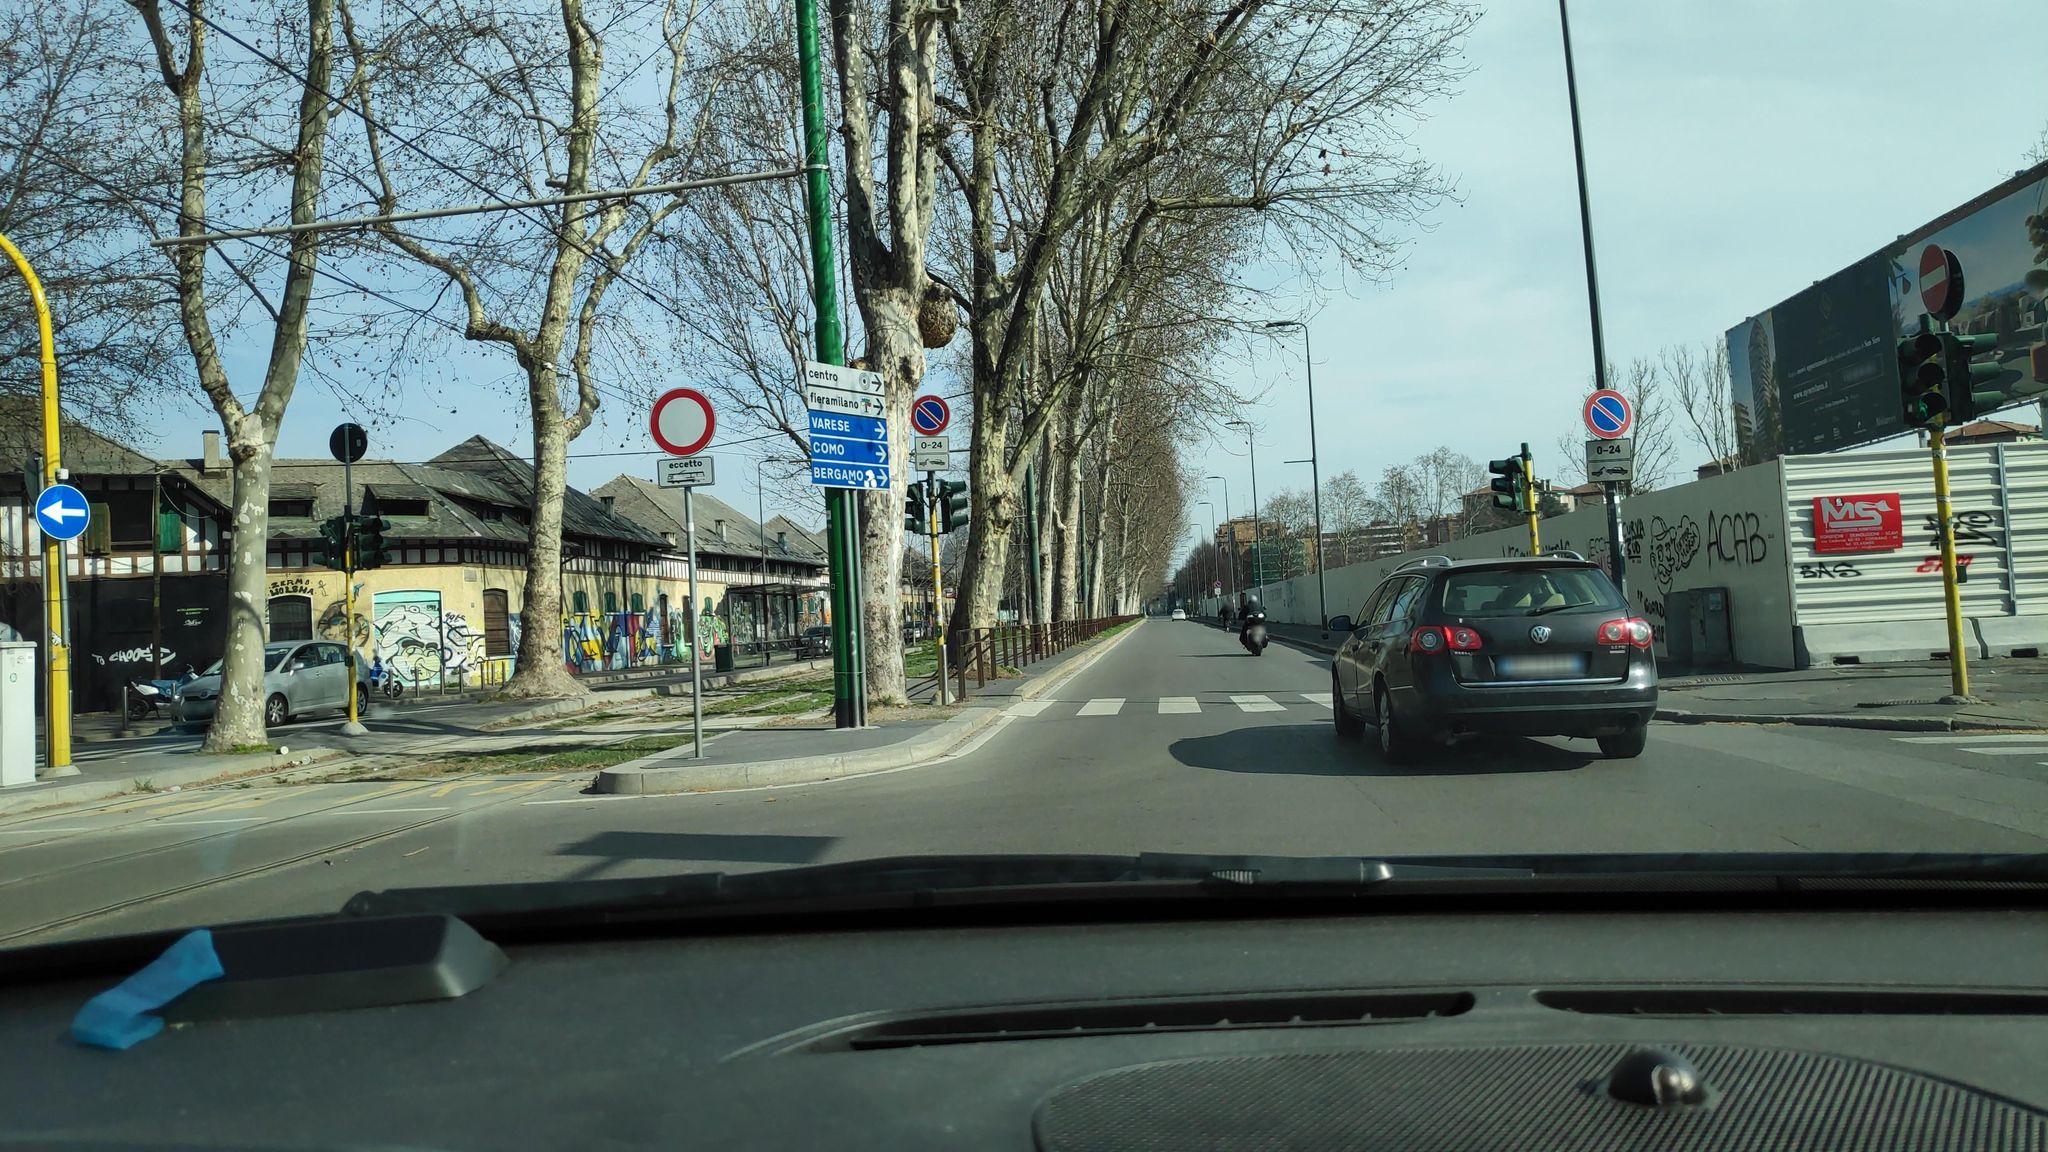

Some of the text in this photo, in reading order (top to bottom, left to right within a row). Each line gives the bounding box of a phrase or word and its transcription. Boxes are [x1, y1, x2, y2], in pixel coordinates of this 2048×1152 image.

[809, 370, 838, 382] centro
[810, 392, 859, 409] fieramilano
[811, 417, 850, 432] VARESE
[813, 442, 845, 455] COMO
[921, 441, 942, 449] 0-24
[1596, 445, 1621, 455] 0-24
[669, 460, 703, 469] eccetto
[814, 467, 864, 481] BERGAMO
[1707, 510, 1767, 566] ACAB
[1800, 562, 1862, 579] BAS
